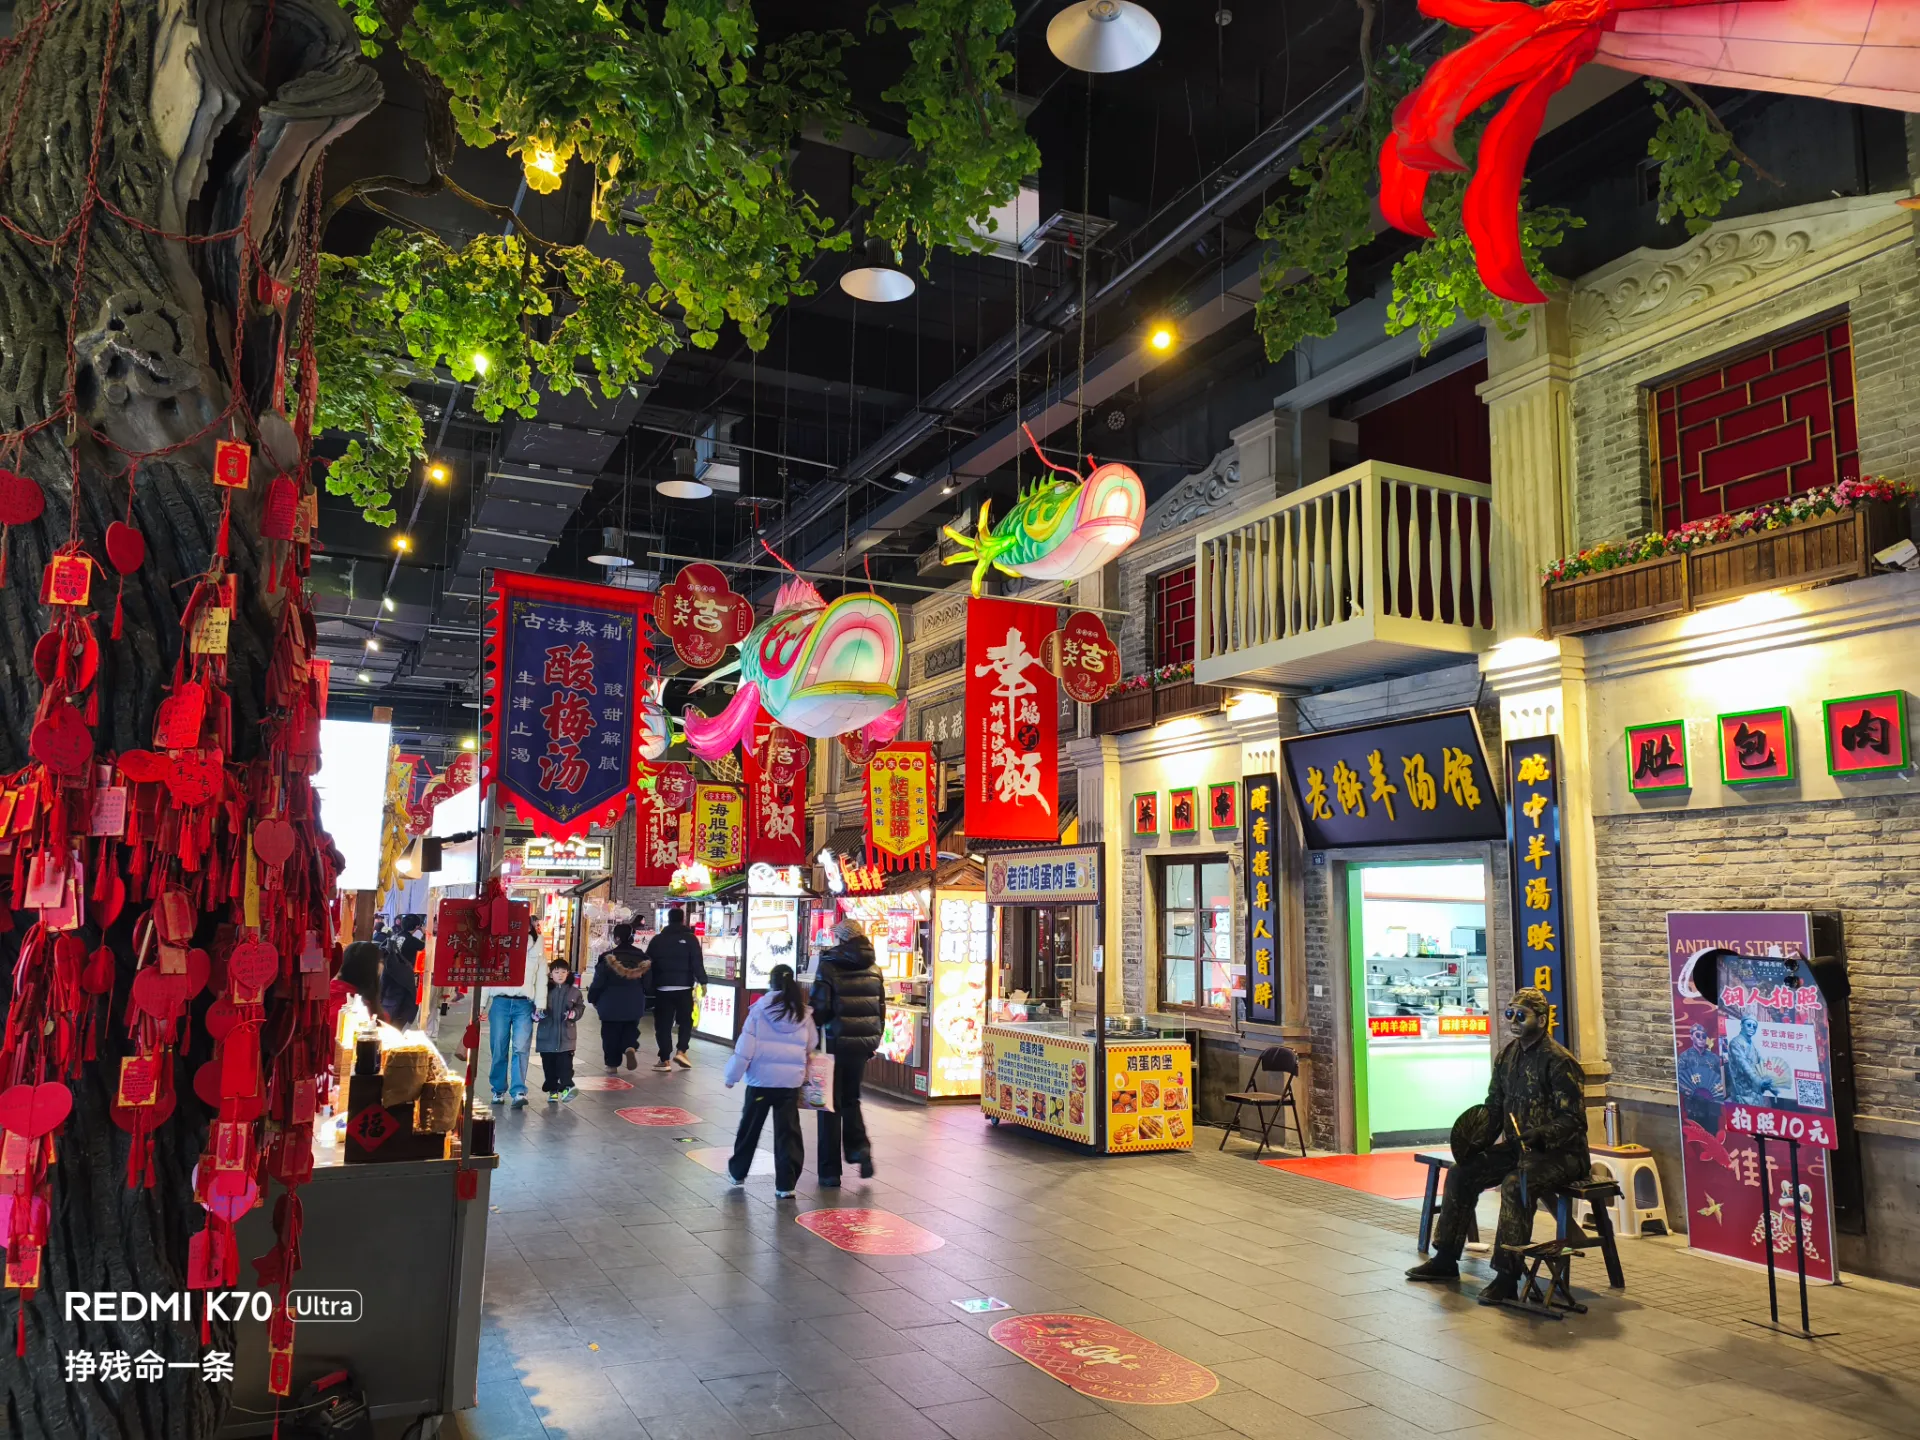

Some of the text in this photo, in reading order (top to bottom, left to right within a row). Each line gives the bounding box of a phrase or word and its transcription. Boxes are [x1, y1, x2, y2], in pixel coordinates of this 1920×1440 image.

[520, 612, 623, 642] 古法熬制
[510, 670, 537, 763] 生津止渴
[538, 641, 598, 795] 酸梅汤
[598, 682, 625, 771] 酸甜解腻
[708, 803, 730, 860] 海胆烤蛋
[1007, 862, 1076, 890] 老街鸡蛋肉堡
[1721, 985, 1822, 1011] 铜人拍照
[1371, 1019, 1418, 1034] 羊肉羊杂汤
[1441, 1018, 1487, 1032] 麻辣羊杂面
[1762, 1040, 1813, 1052] 欢迎拍照打卡
[1126, 1054, 1173, 1072] 鸡蛋肉堡
[357, 1111, 387, 1139] 福
[1731, 1106, 1829, 1145] 拍照10元
